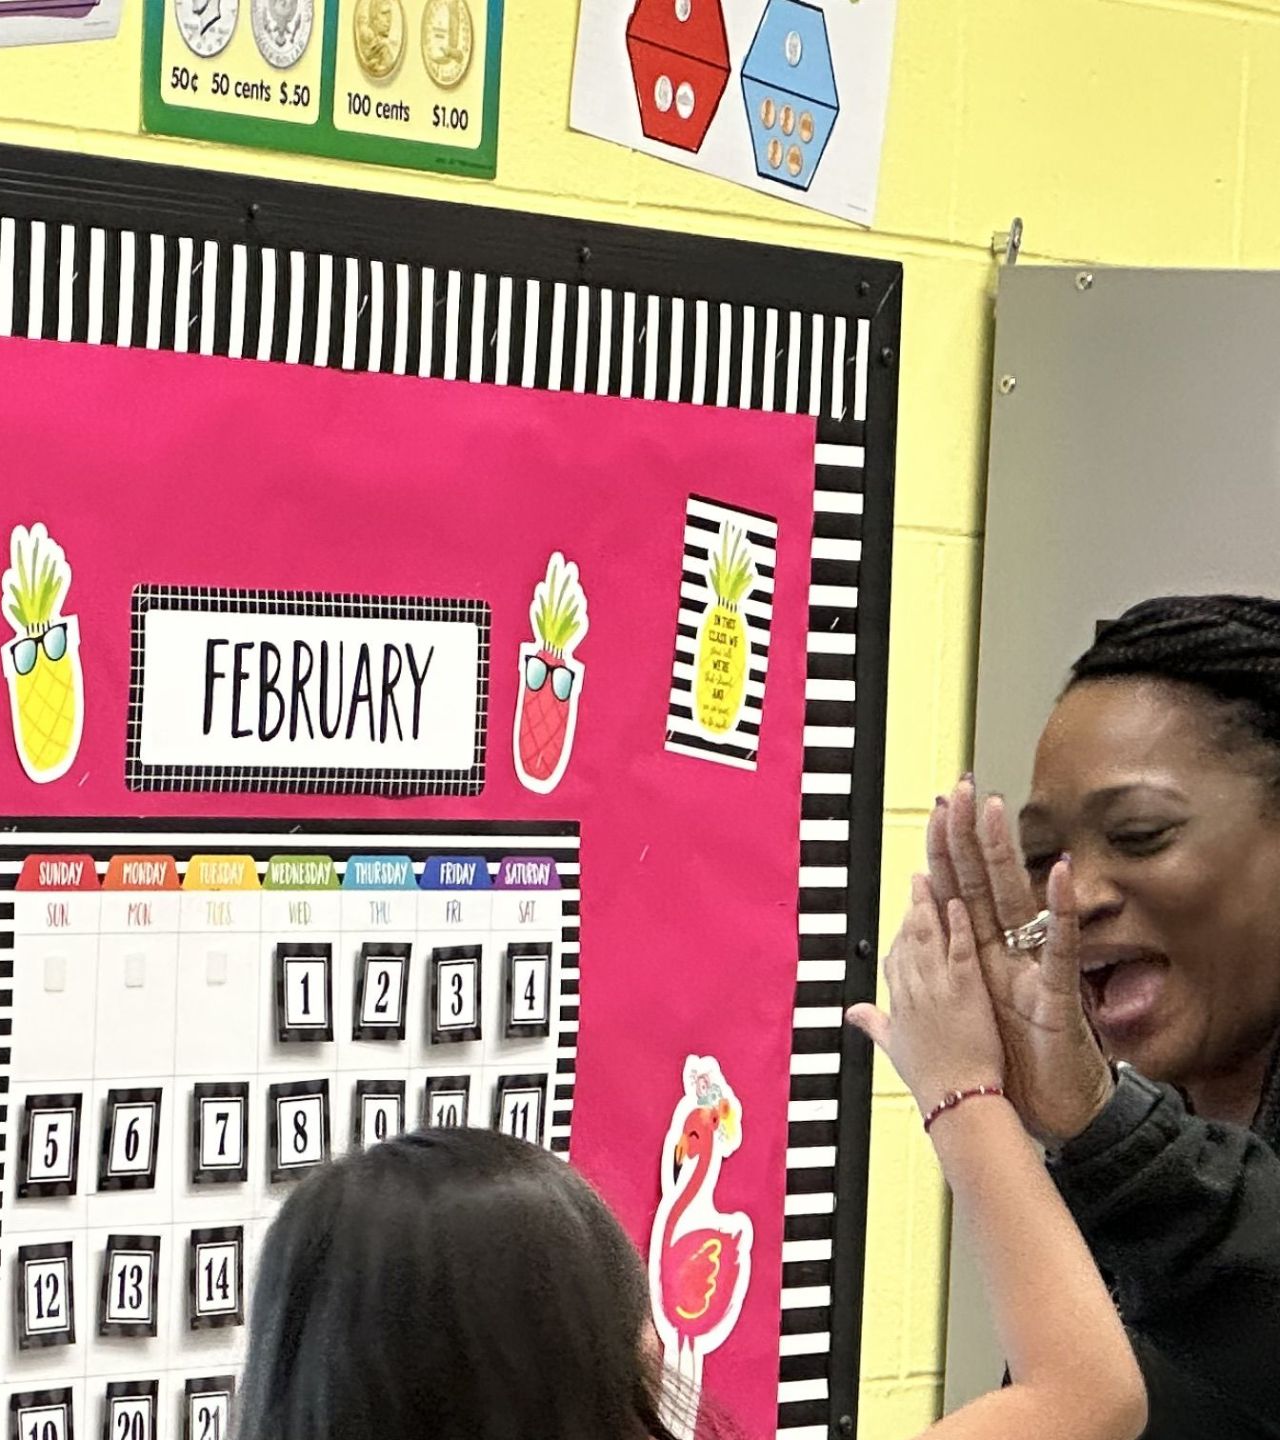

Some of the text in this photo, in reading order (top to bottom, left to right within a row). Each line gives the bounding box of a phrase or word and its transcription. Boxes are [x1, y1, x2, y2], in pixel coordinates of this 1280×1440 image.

[170, 66, 311, 107] 50¢ 50 cents $.50
[347, 92, 469, 131] 100 cents $1.00
[202, 637, 434, 744] FEBRUARY
[39, 861, 551, 887] SUNDAY MONDAY TUESDAY WEDNESDAY THURSDAY FRIDAY SATURDAY
[299, 967, 536, 1017] 1 2 3 4
[43, 1123, 59, 1169] 5
[124, 1116, 141, 1163] 6
[215, 1111, 231, 1158] 7
[293, 1109, 309, 1155] 8
[33, 1256, 230, 1320] 12 13 14
